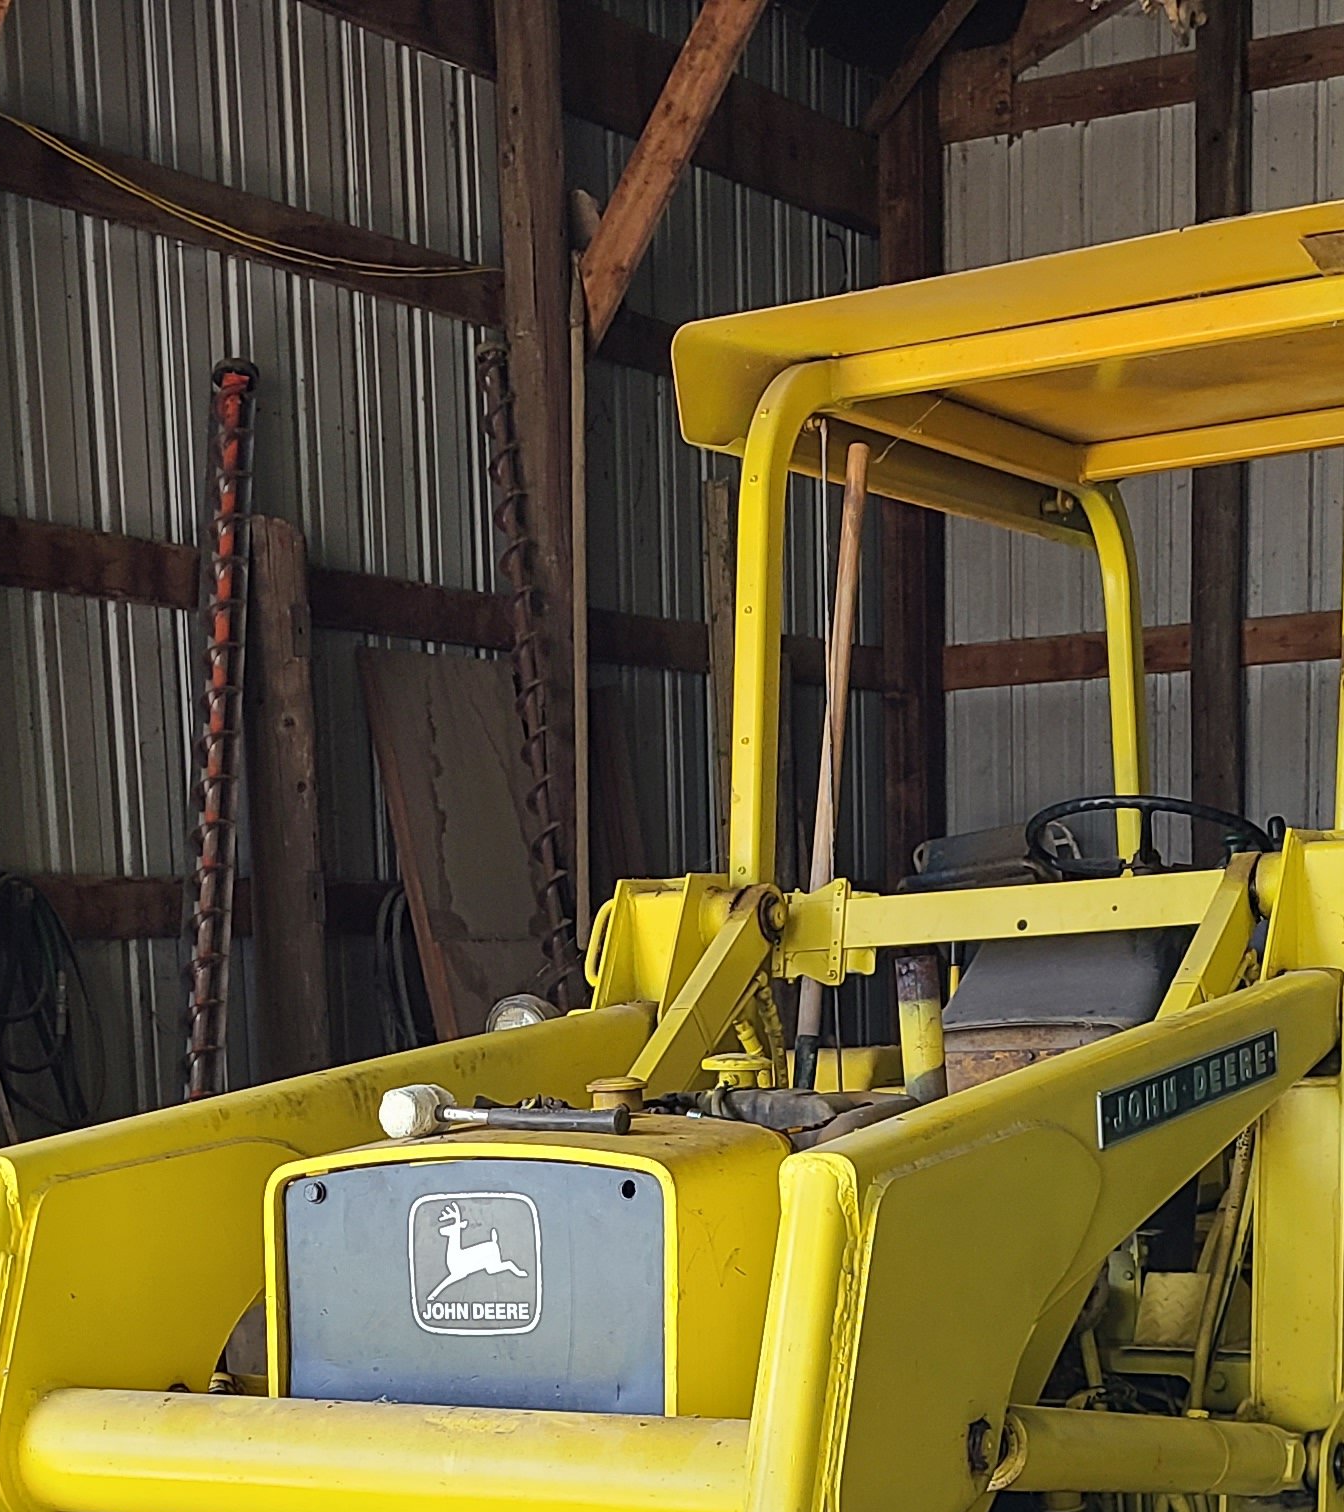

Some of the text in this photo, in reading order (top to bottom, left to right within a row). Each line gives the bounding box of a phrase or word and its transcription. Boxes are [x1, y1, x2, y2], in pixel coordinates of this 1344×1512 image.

[1113, 1040, 1268, 1132] JOHN DEERE
[422, 1301, 530, 1321] JOHN DEERE
